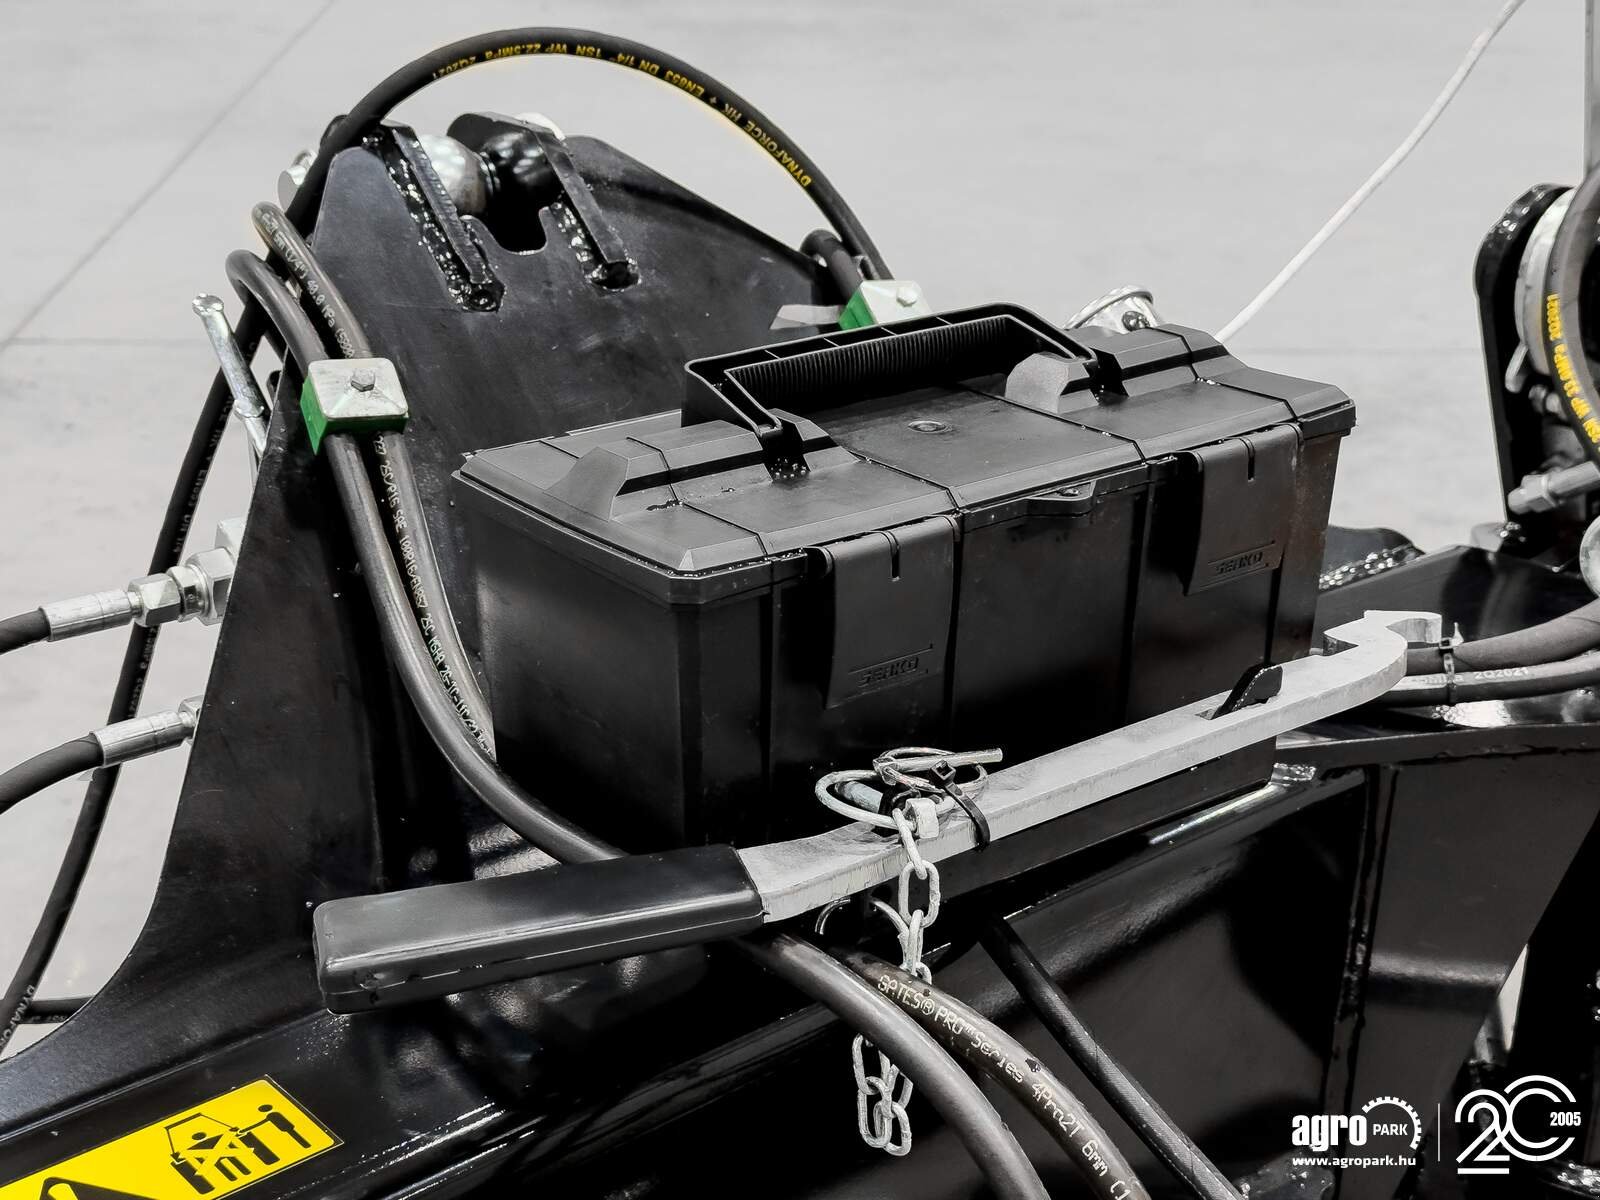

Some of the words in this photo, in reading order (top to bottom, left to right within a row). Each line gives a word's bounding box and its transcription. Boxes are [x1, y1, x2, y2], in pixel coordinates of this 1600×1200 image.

[638, 59, 660, 75] DN
[724, 103, 743, 122] HK
[744, 120, 813, 188] DYNAFORCE
[1081, 1139, 1108, 1177] 6mm
